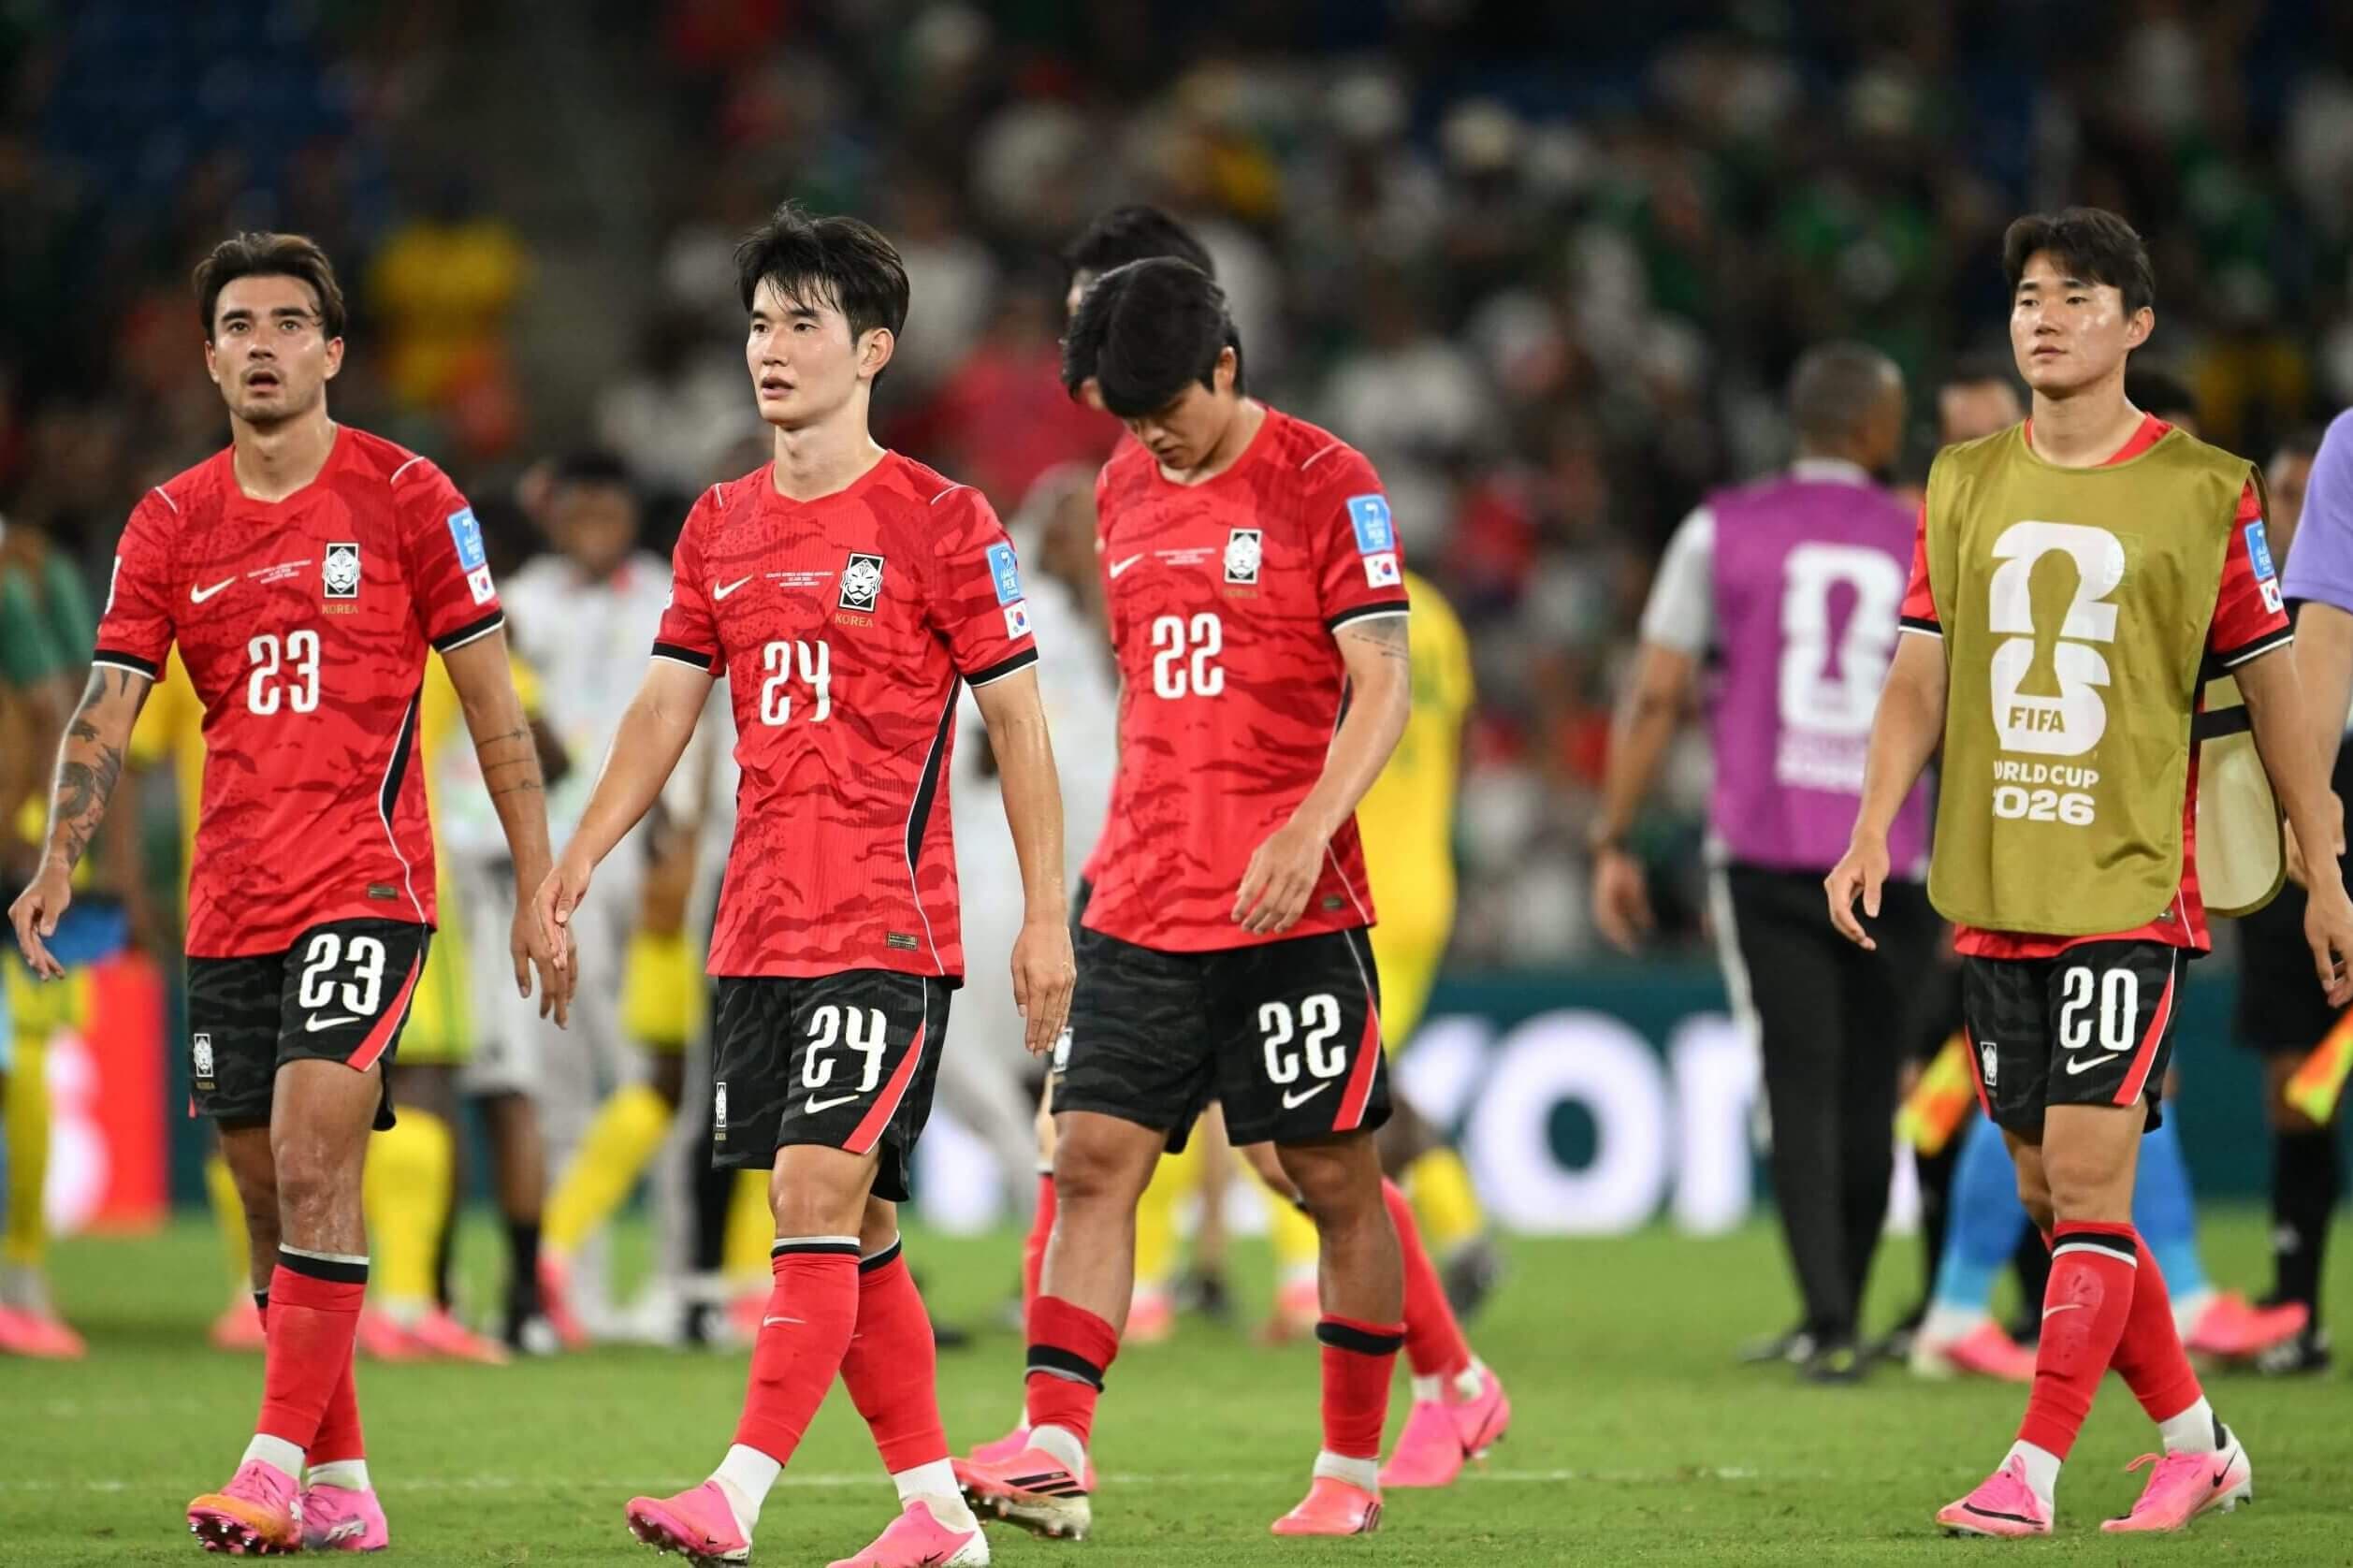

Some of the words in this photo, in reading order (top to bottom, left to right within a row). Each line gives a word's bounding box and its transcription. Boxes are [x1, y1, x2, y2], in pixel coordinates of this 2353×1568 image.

[322, 603, 359, 615] KOREA
[835, 612, 874, 629] KOREA
[247, 630, 320, 716] 23
[761, 640, 832, 727] 24
[1152, 612, 1225, 700] 22
[2008, 706, 2066, 733] FIFA
[1992, 785, 2096, 826] 026
[298, 933, 386, 1016] 23
[2059, 965, 2140, 1052] 20
[801, 1005, 888, 1093] 24
[1257, 994, 1347, 1084] 22
